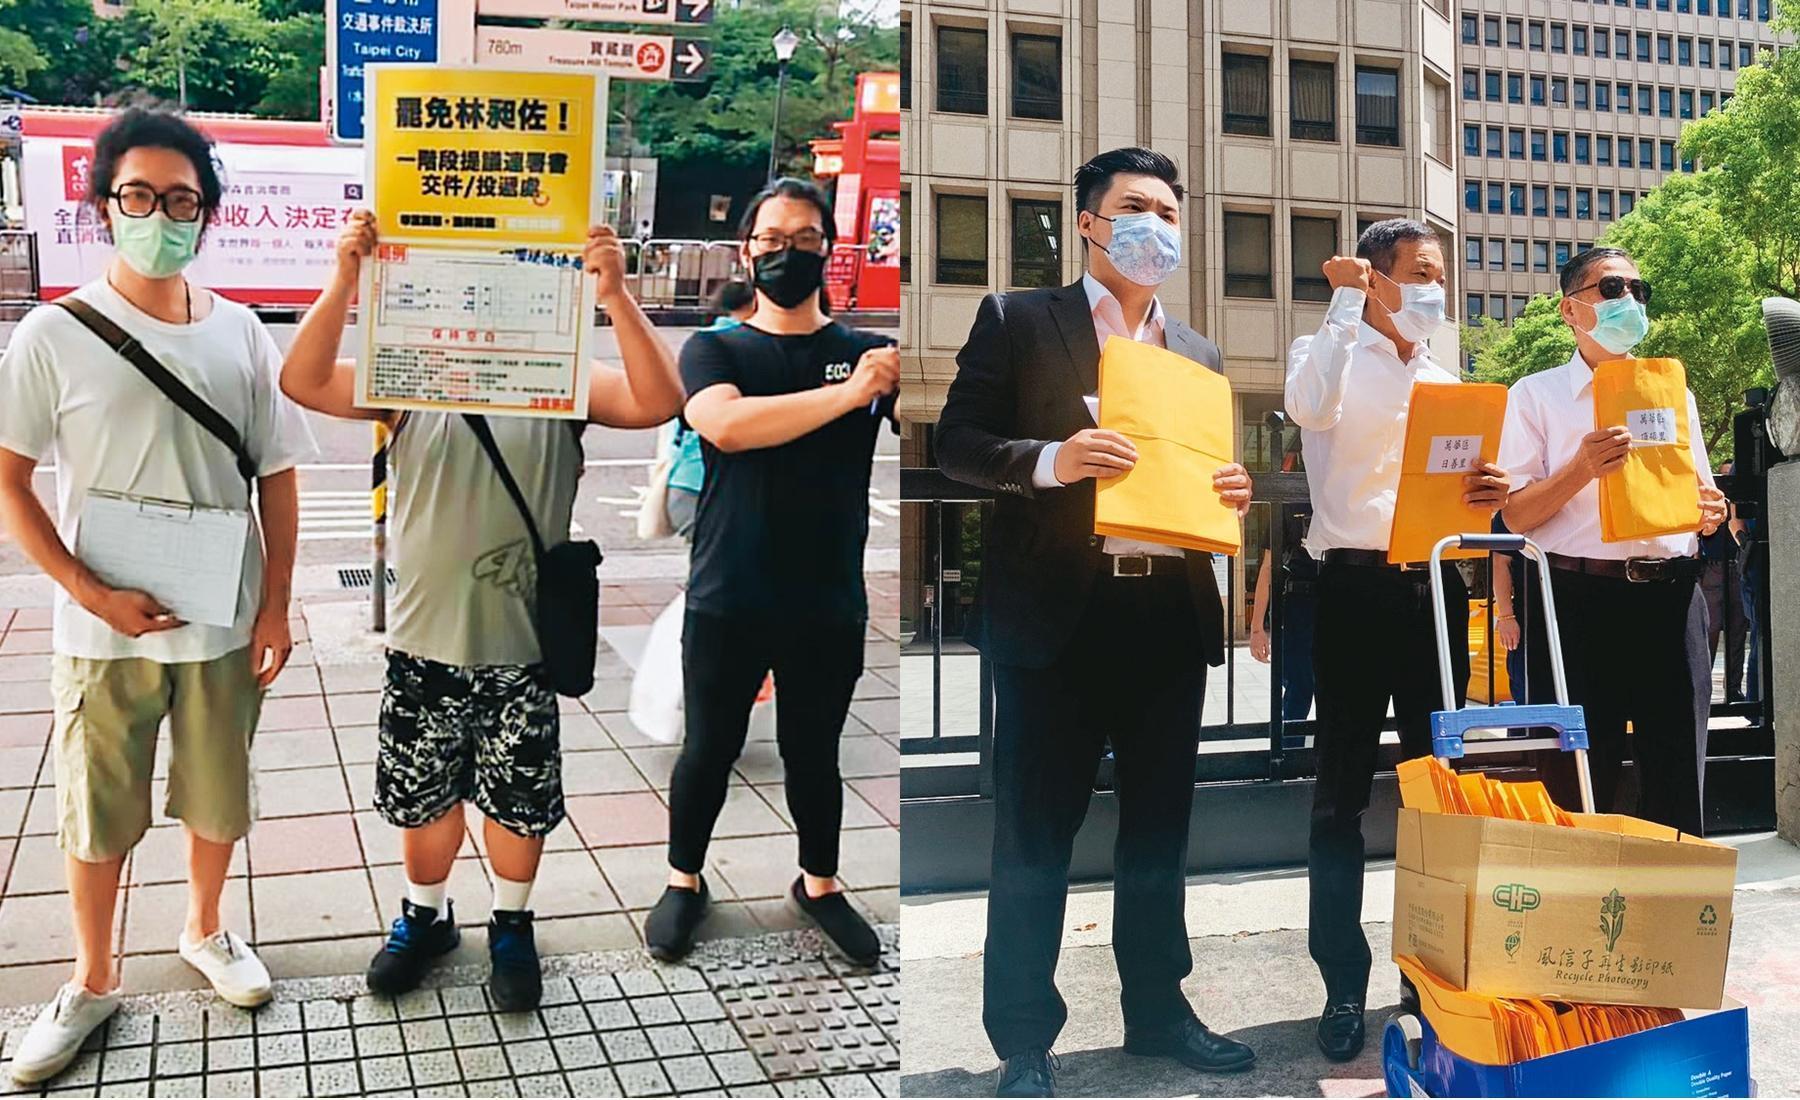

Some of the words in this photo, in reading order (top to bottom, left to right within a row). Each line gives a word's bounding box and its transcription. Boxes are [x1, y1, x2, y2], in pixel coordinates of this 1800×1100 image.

[353, 42, 391, 57] Taipei
[395, 45, 421, 60] City
[396, 97, 569, 131] 罷免林昶佐！
[1537, 946, 1675, 977] 風信子再生影印紙
[1555, 969, 1594, 984] Recycle
[1597, 972, 1649, 990] Photocopy
